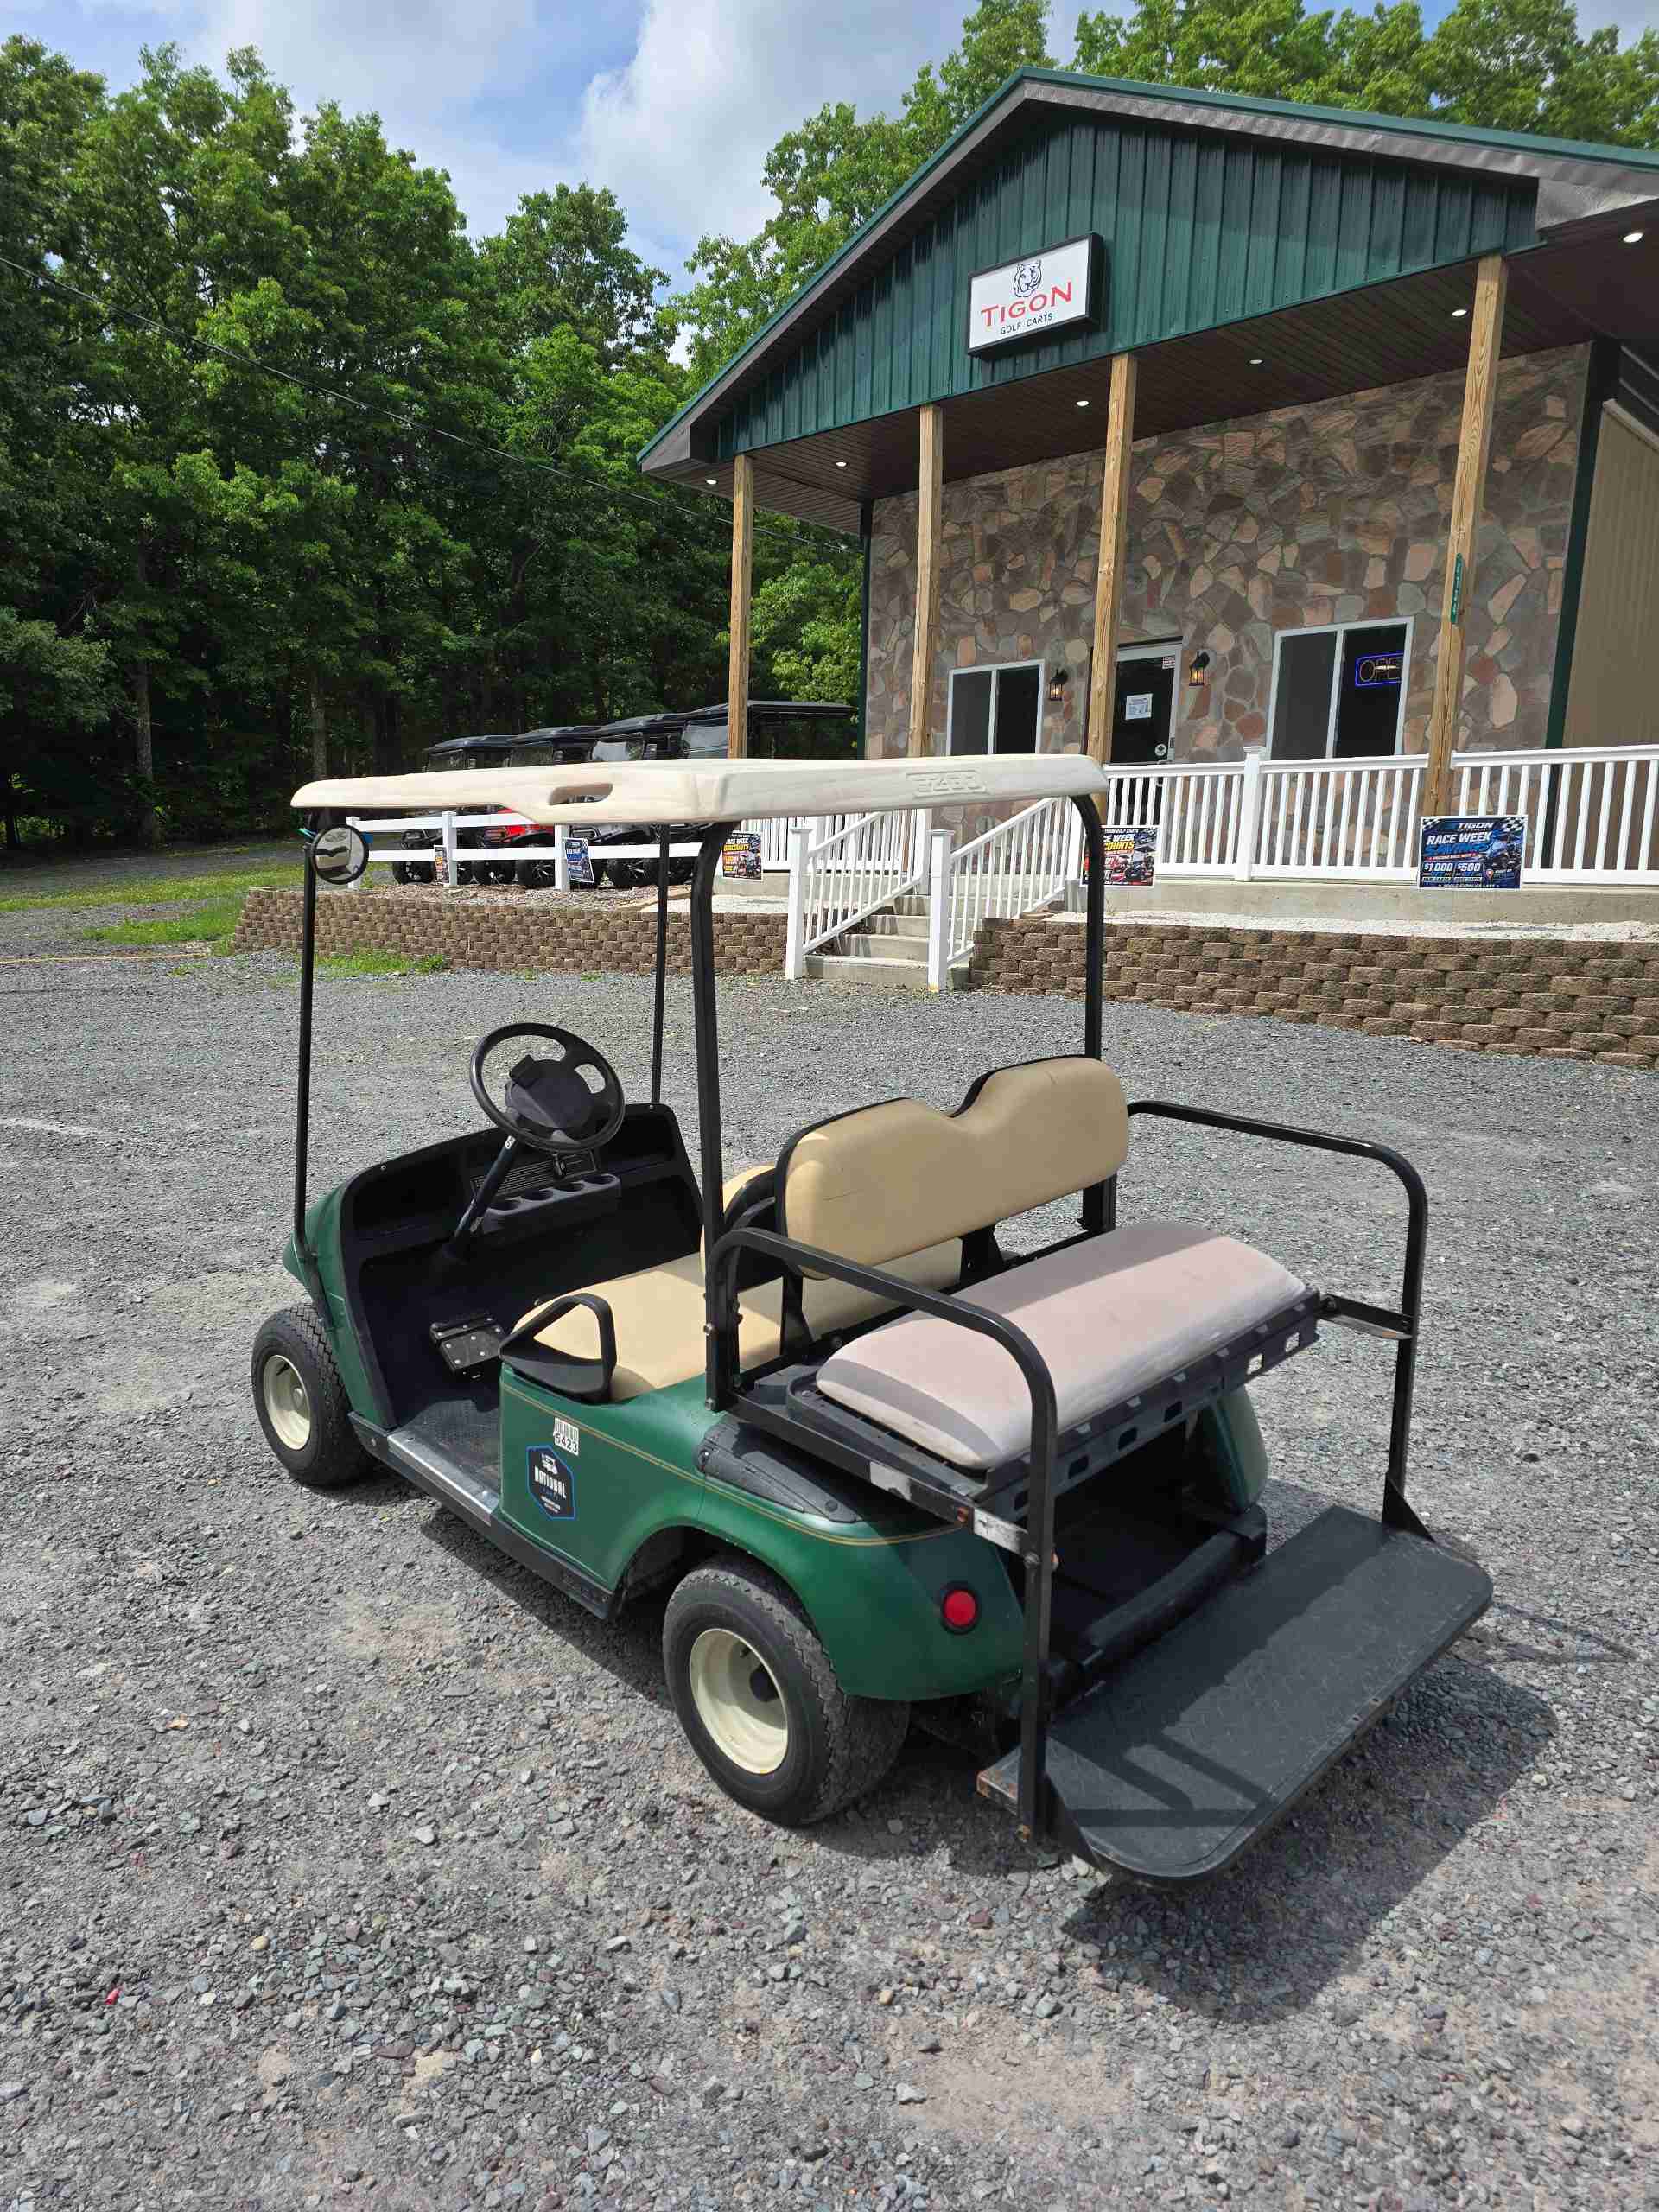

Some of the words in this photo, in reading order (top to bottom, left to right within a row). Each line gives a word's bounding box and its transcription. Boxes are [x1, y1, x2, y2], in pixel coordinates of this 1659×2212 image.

[981, 281, 1072, 327] TIGON
[1000, 322, 1021, 335] GOLF
[1026, 312, 1053, 327] CARTS
[1427, 834, 1458, 845] RACE
[1459, 831, 1493, 843] WEEK
[1457, 862, 1481, 872] $500
[554, 1433, 578, 1453] 5423
